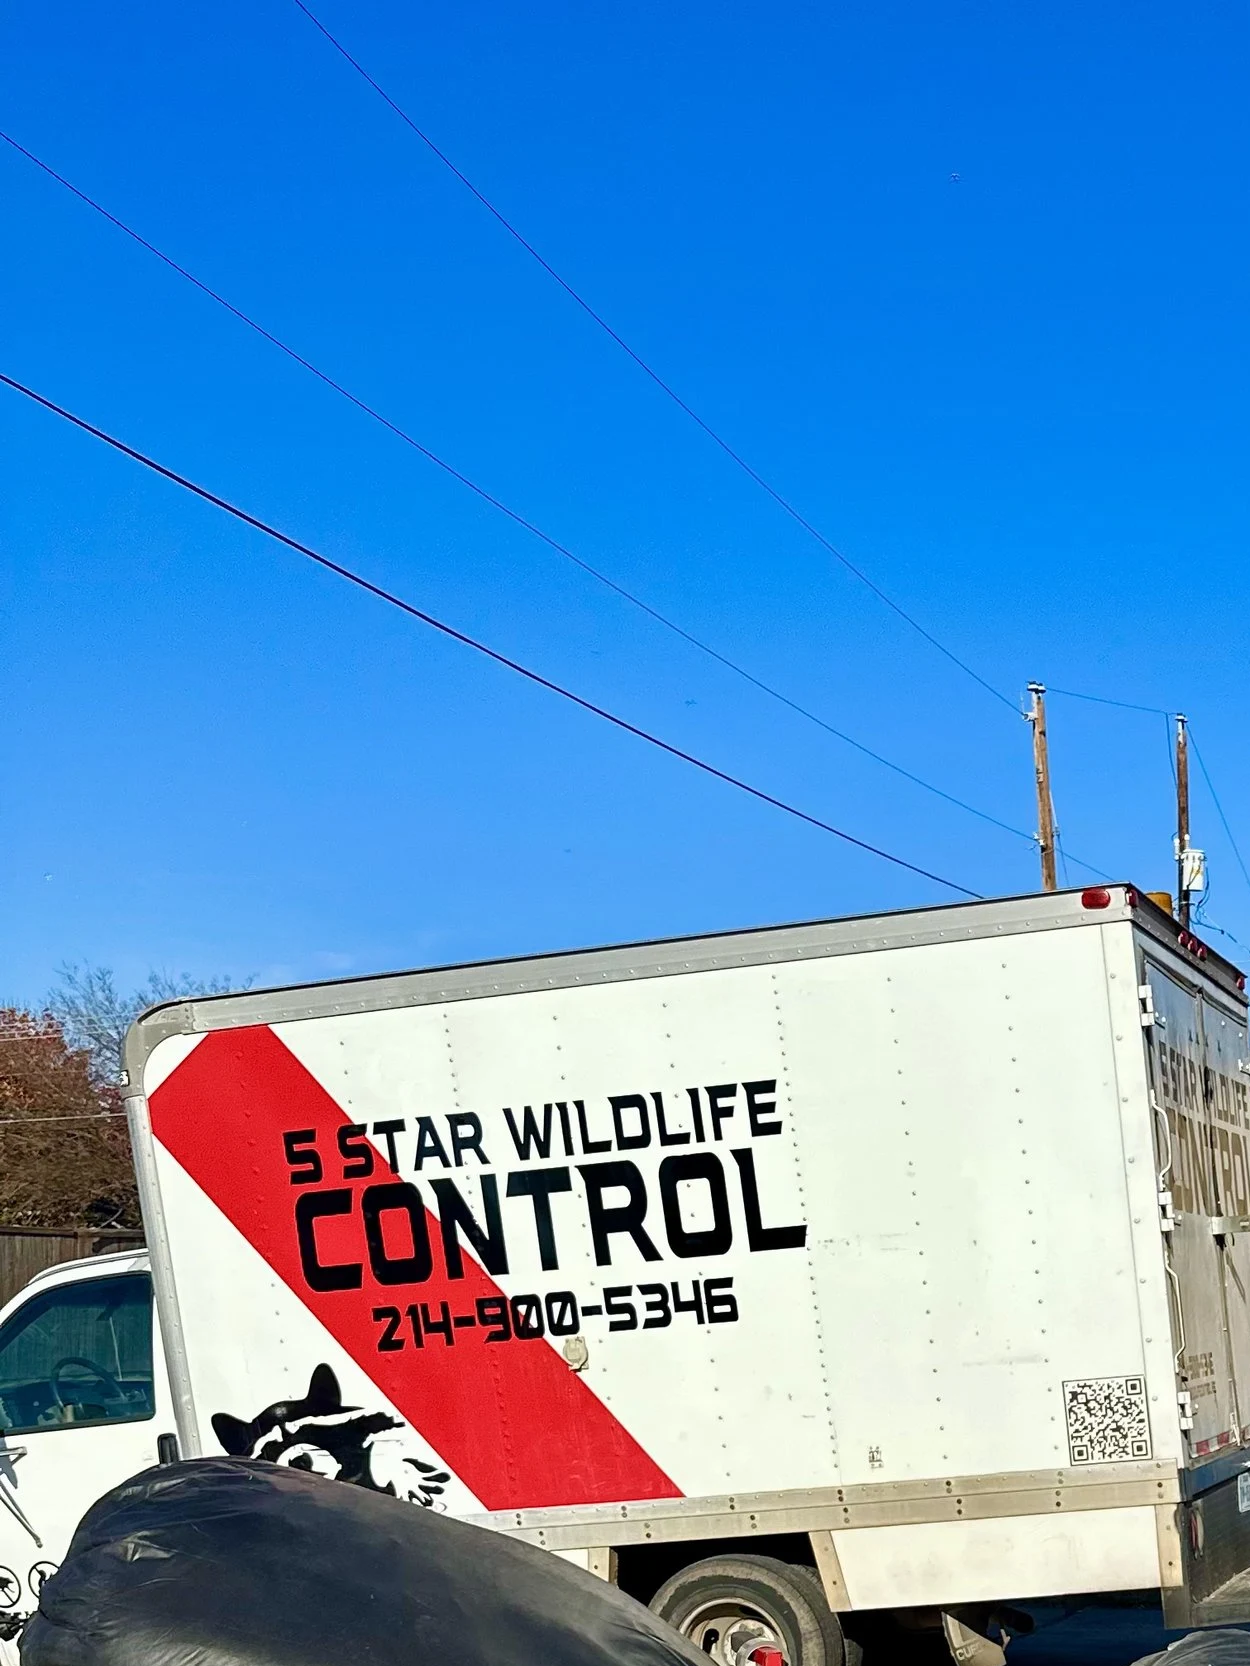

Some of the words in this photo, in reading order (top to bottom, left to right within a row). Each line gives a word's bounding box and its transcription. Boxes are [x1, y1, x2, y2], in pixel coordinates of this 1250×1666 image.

[282, 1128, 324, 1186] 5
[336, 1110, 491, 1181] STAR
[502, 1079, 784, 1162] WILDLIFE
[294, 1147, 809, 1294] CONTROL
[371, 1276, 740, 1353] 214-900-5346
